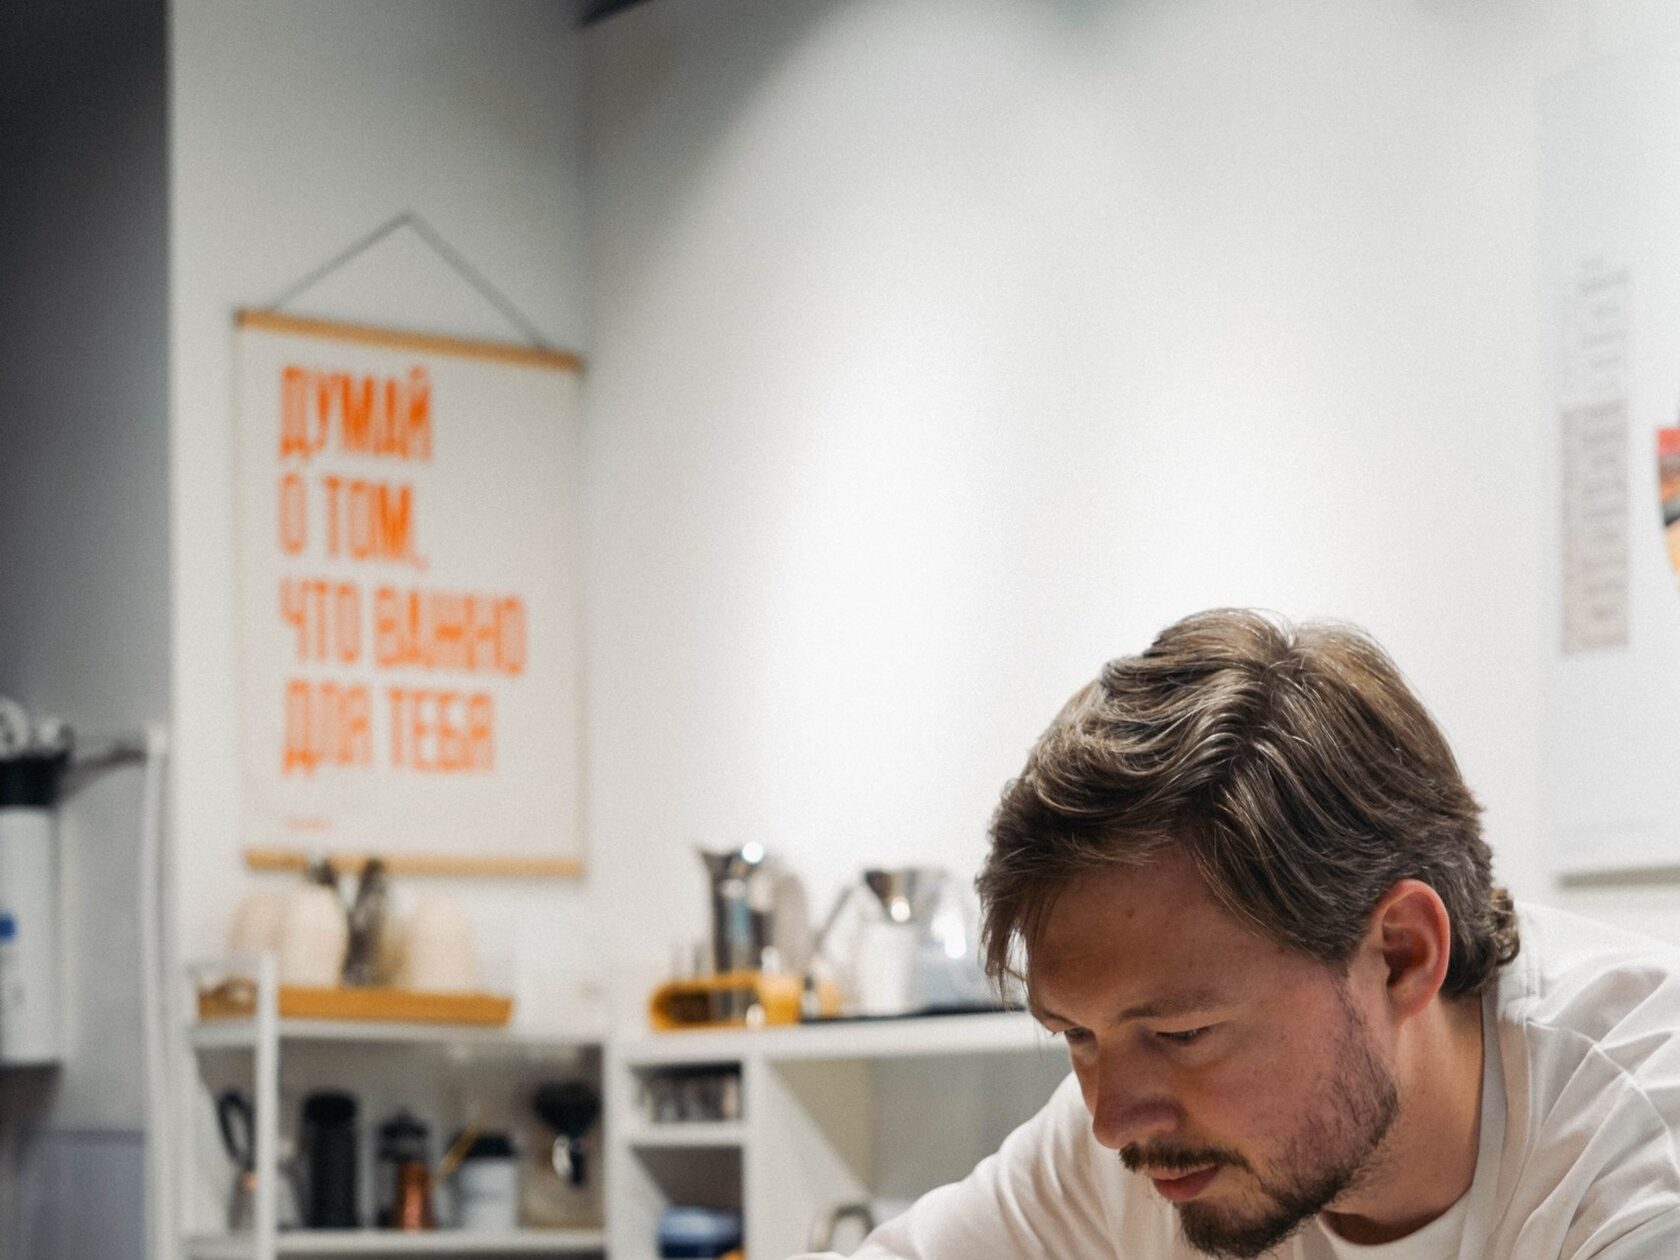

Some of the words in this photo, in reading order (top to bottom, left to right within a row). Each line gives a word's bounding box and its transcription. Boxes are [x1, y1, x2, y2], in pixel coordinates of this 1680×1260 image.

[279, 364, 433, 462] ДУМАЙ
[278, 470, 308, 557] О
[322, 473, 428, 570] ТОМ,
[279, 577, 362, 664] ЧТО
[373, 584, 527, 677] ВАЖНО
[281, 677, 373, 778] ДЛЯ
[387, 686, 495, 776] ТЕБЯ
